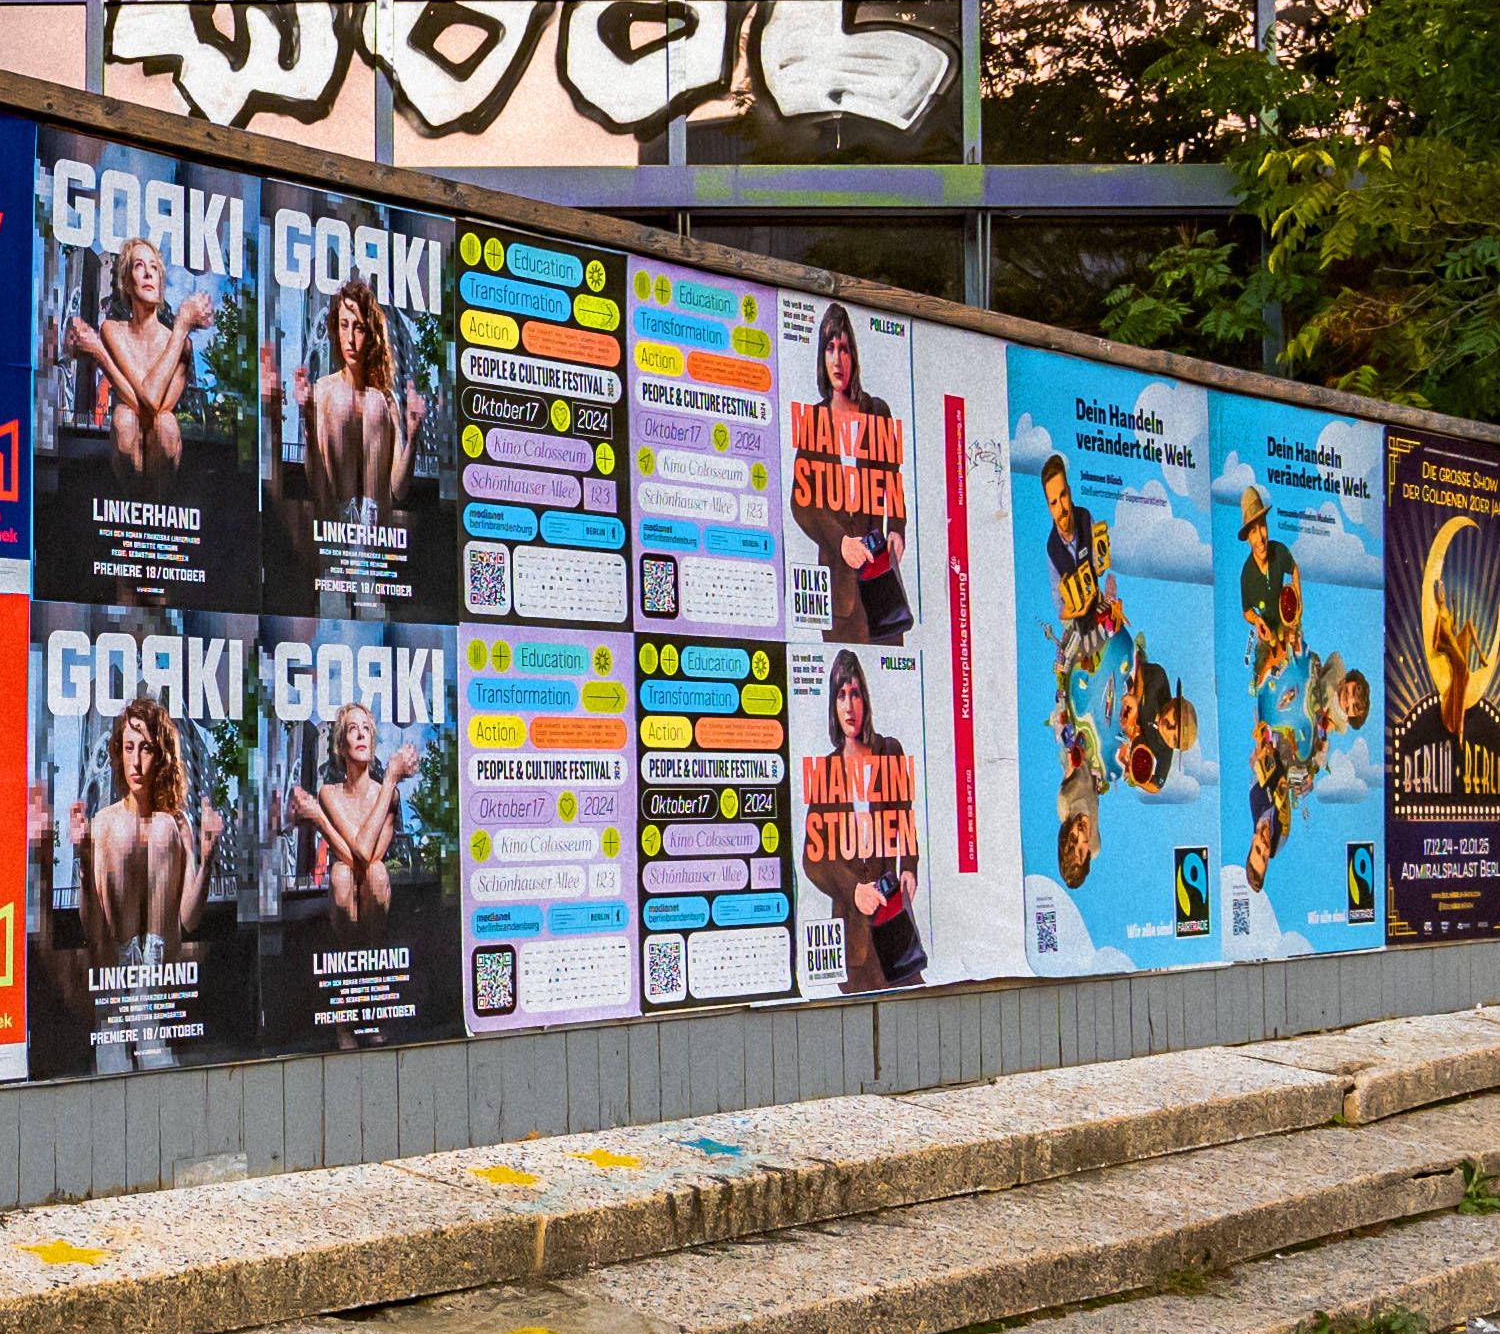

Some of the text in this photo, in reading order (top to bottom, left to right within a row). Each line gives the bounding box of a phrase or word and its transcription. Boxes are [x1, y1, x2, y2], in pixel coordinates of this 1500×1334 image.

[1075, 398, 1163, 435] Dein Handeln
[791, 401, 903, 464] MANZINI
[1076, 430, 1196, 468] verändert die Welt.
[1267, 435, 1342, 468] Dein Handeln
[794, 457, 904, 519] STUDIEN
[1268, 466, 1370, 499] verändert die Welt.
[93, 498, 200, 531] LINKERHAND
[313, 520, 407, 549] LINKERHAND
[794, 568, 828, 592] VOLKS
[794, 591, 829, 616] BÜHNE
[521, 648, 583, 669] Education.
[476, 683, 574, 706] Transformation.
[477, 760, 611, 780] PEOPLE & CULTURE FESTIVAL
[803, 755, 915, 804] MANZINI
[1403, 740, 1451, 794] BERLIN
[584, 797, 614, 816] 2024
[807, 809, 917, 863] STUDIEN
[313, 947, 409, 975] LINKERHAND
[88, 962, 198, 992] LINKERHAND
[90, 1028, 139, 1045] PREMIERE
